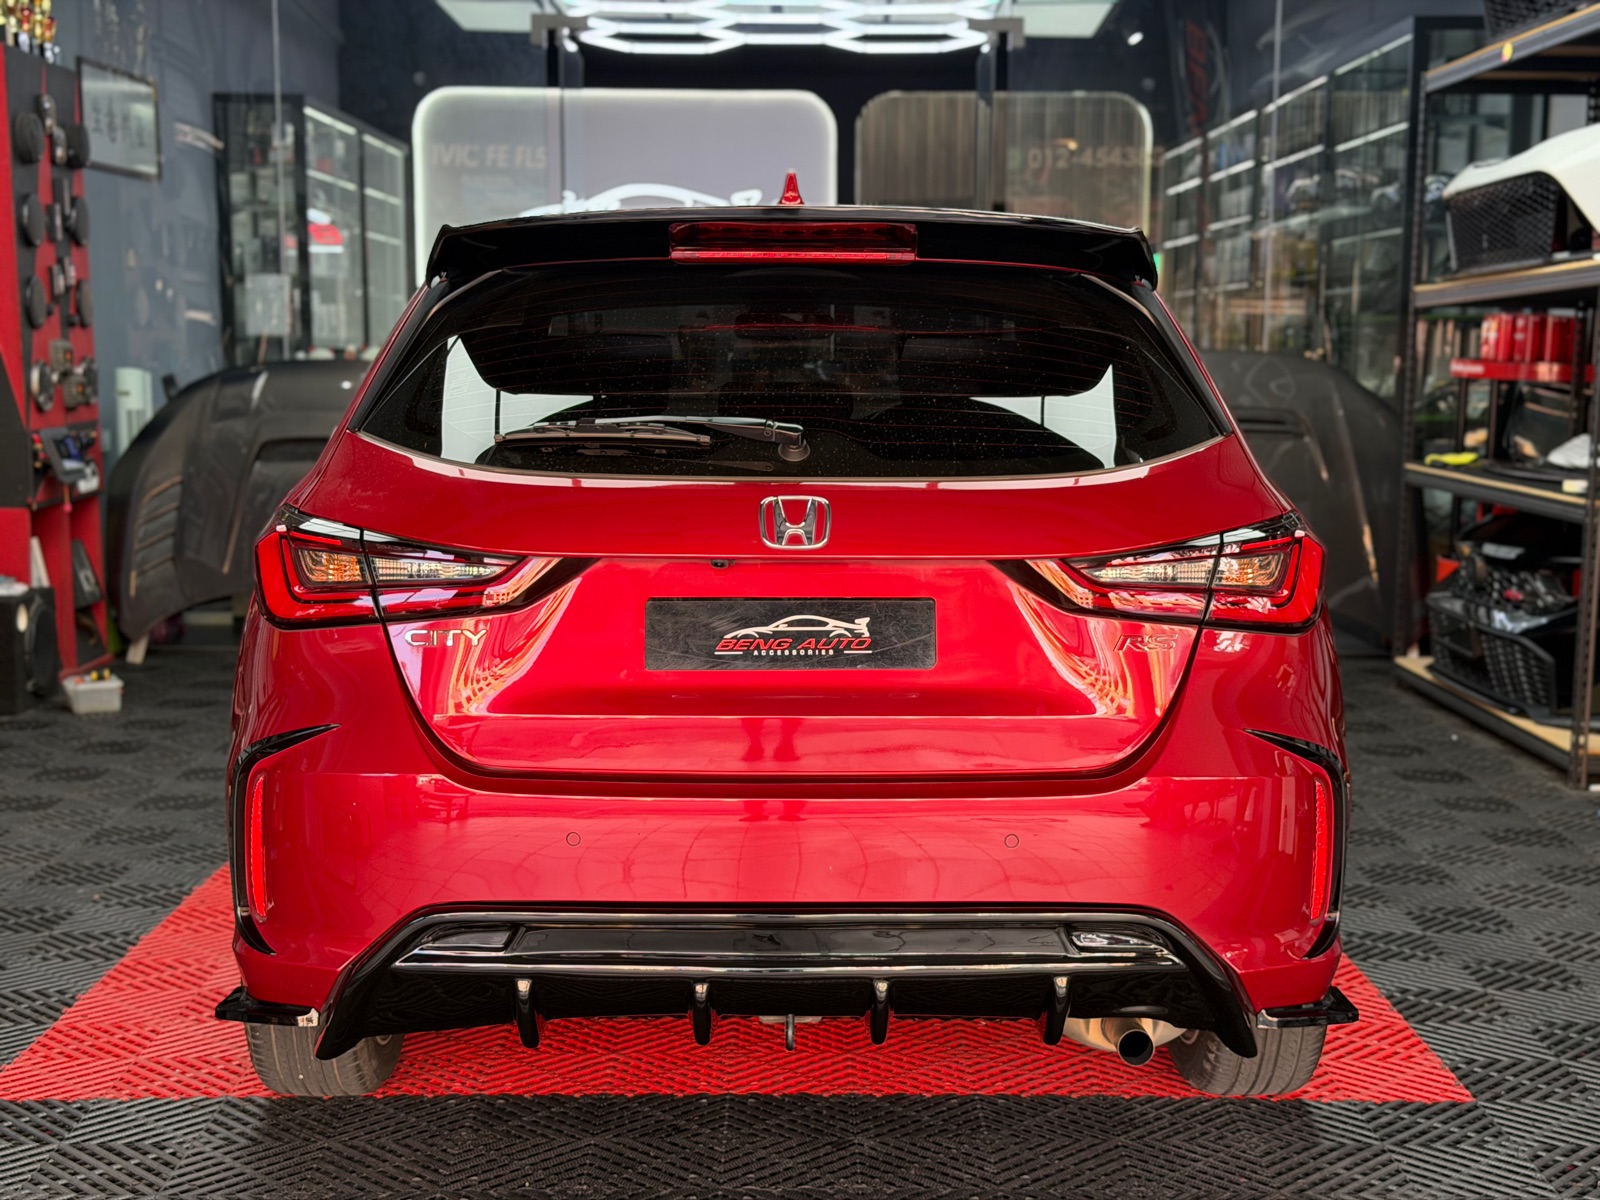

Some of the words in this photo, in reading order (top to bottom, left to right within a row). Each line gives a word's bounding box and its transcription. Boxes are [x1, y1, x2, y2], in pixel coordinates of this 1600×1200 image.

[404, 629, 487, 646] CITY
[715, 638, 793, 650] BENG
[797, 638, 872, 650] AUTO
[1113, 634, 1178, 652] RS
